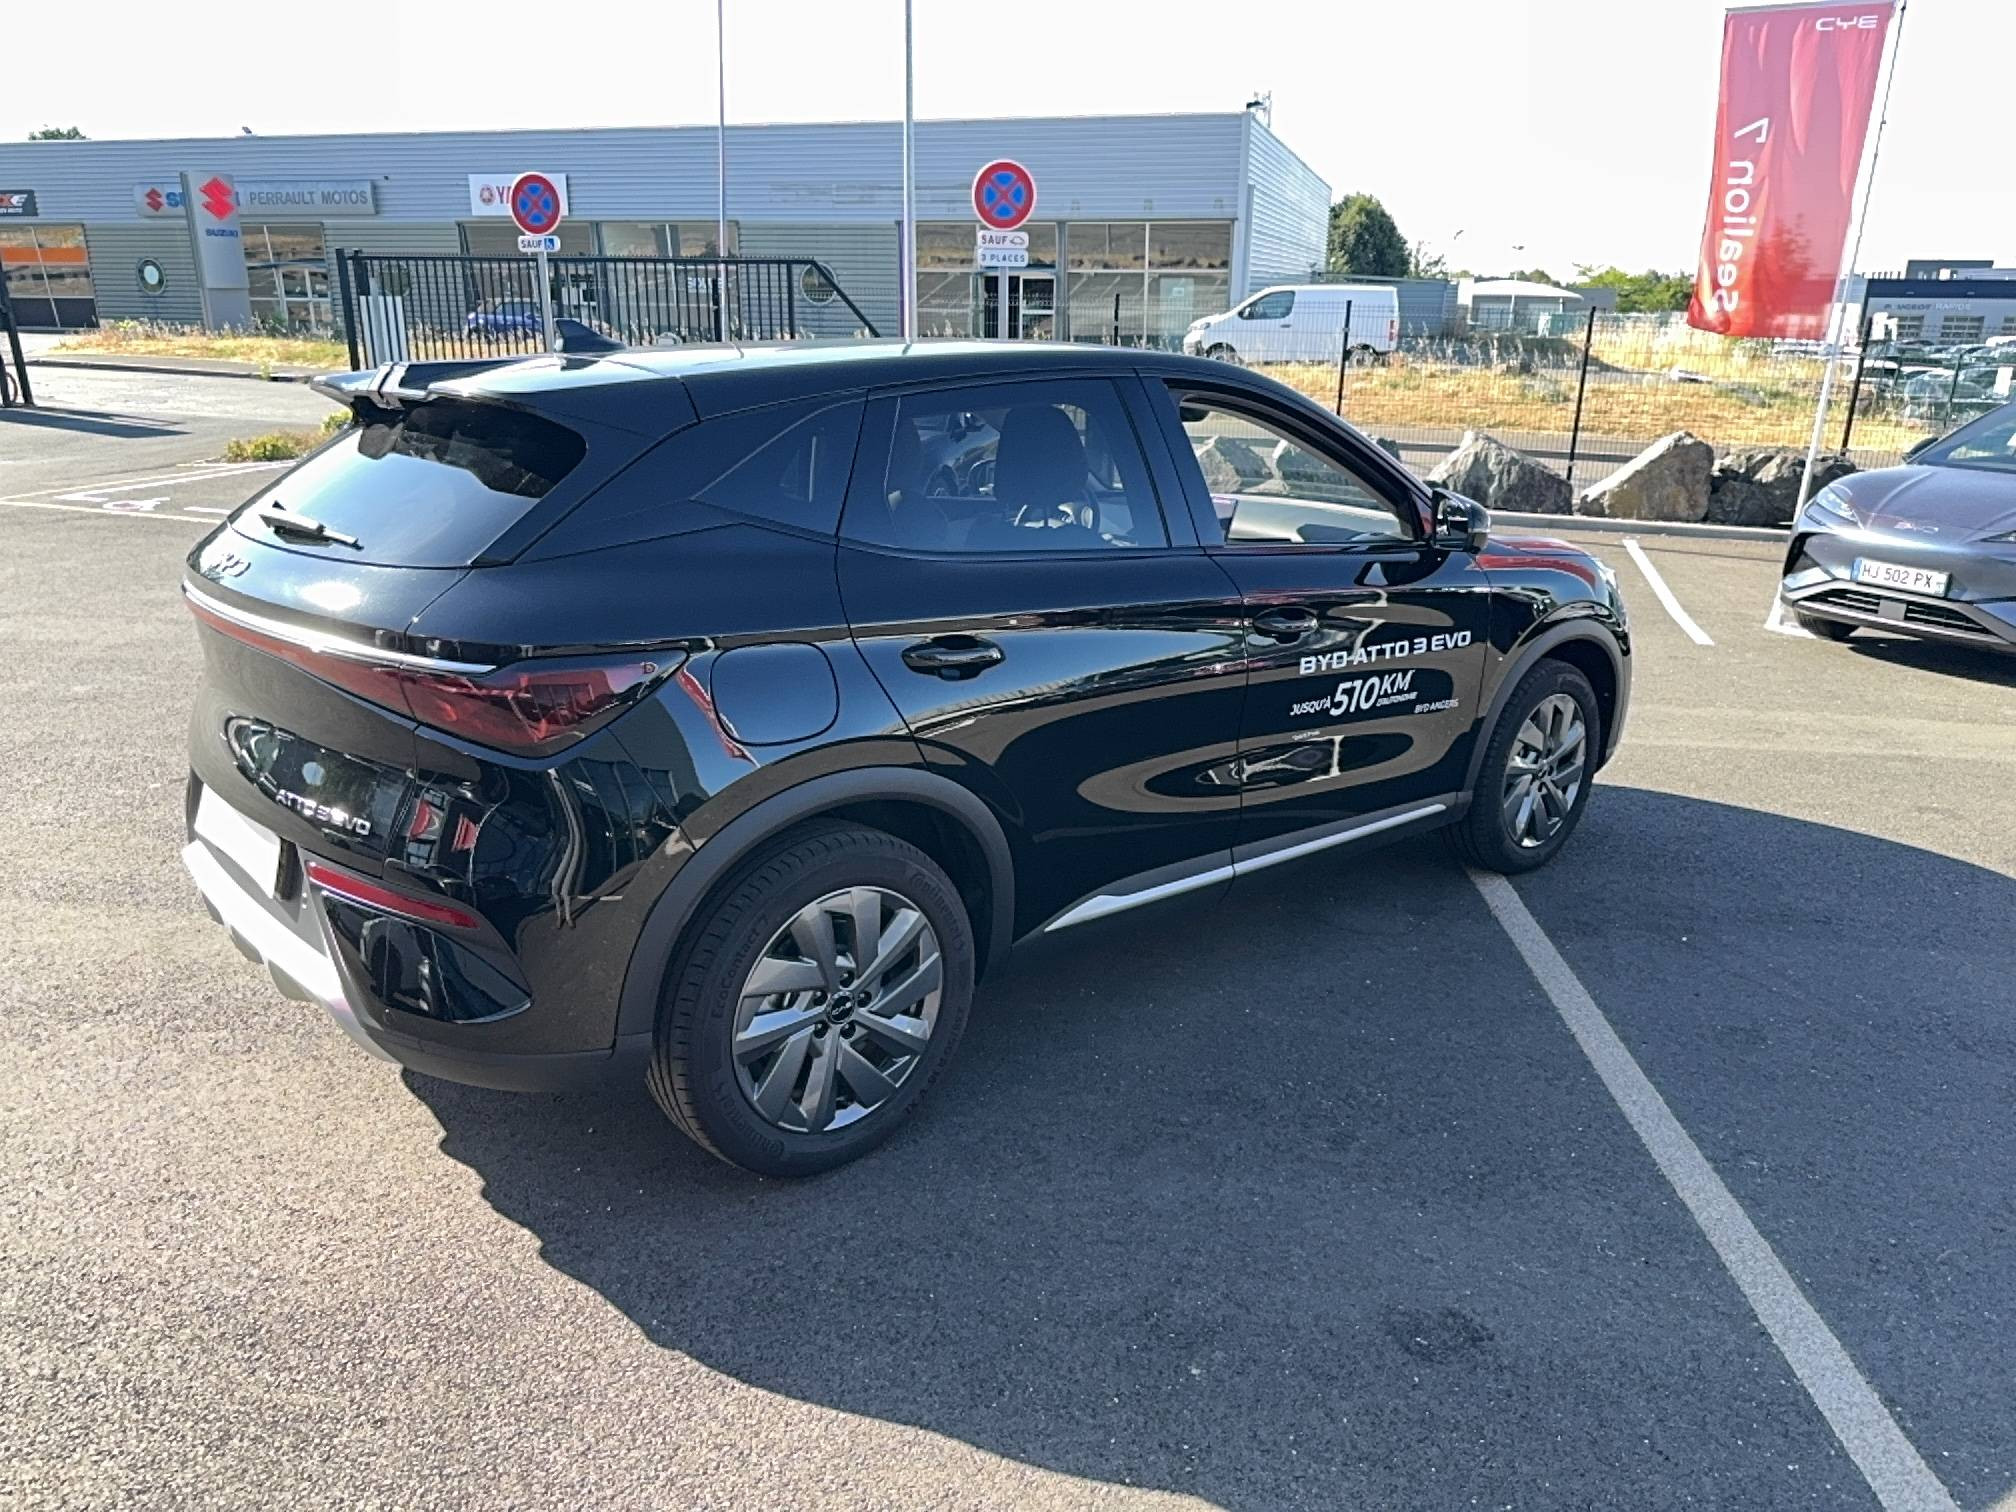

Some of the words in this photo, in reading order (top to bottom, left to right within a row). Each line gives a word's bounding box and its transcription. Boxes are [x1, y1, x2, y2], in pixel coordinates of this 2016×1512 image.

[249, 191, 315, 205] PERRAULT
[321, 190, 369, 205] MOTOS
[521, 240, 543, 249] SAUF
[981, 235, 1008, 245] SAUF
[990, 254, 1025, 262] PLACES
[1862, 564, 1879, 578] HJ
[1883, 568, 1910, 584] 502
[1914, 572, 1933, 588] PX
[1300, 651, 1348, 675] BYD
[1353, 640, 1410, 665] ATTO
[1413, 637, 1428, 655] 3
[1431, 630, 1472, 651] EVO
[1329, 675, 1381, 717] 510
[1379, 669, 1415, 695] KM
